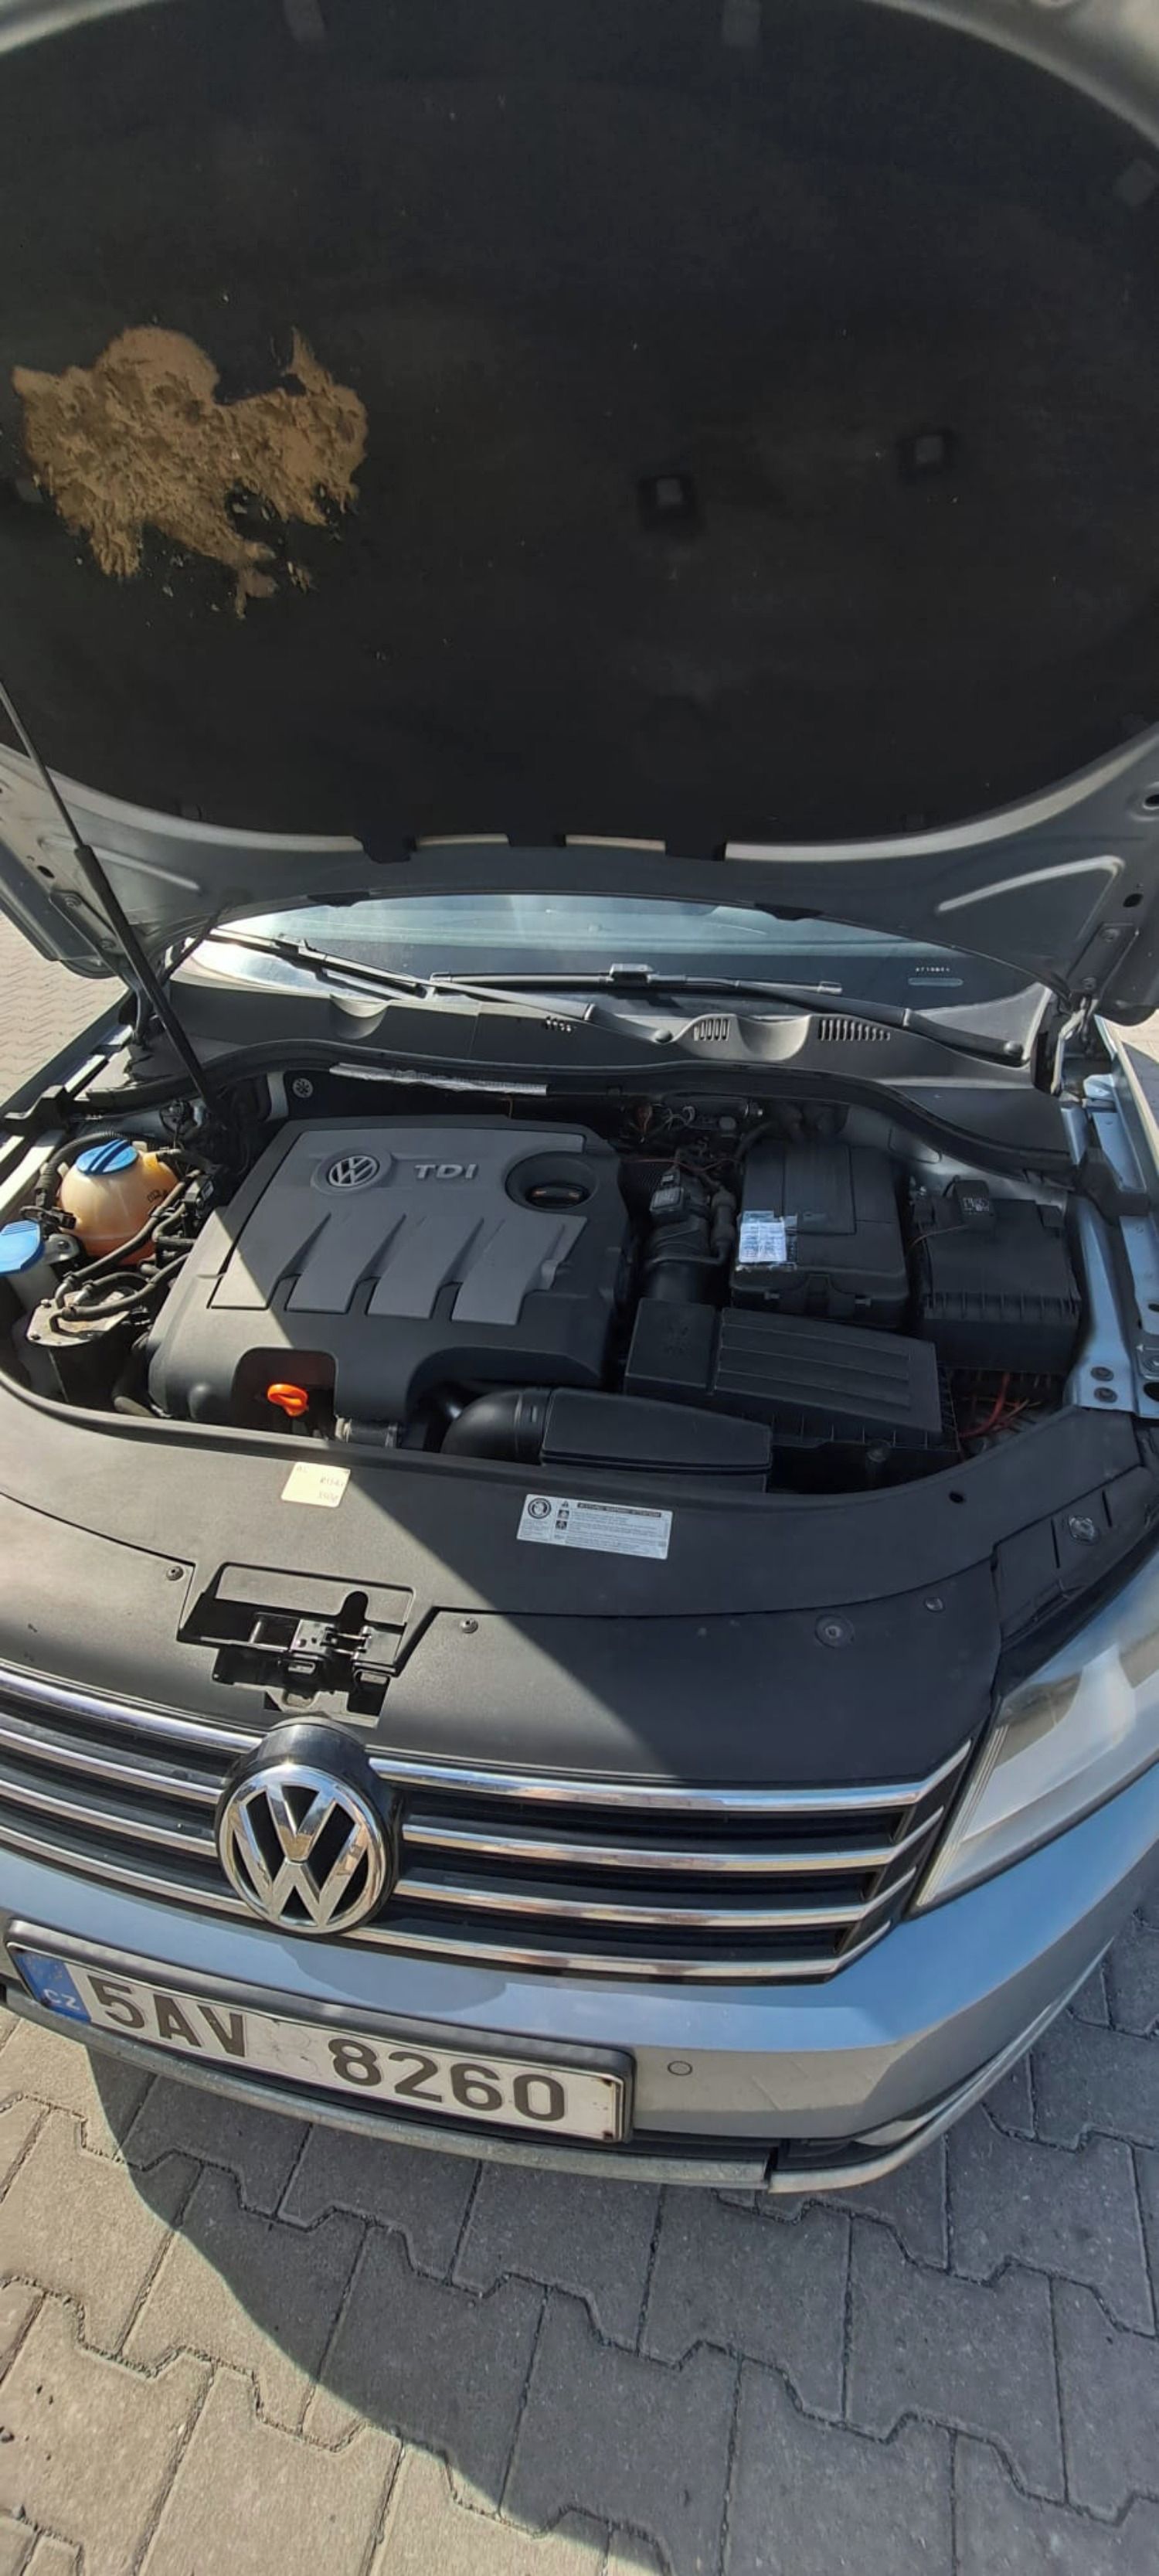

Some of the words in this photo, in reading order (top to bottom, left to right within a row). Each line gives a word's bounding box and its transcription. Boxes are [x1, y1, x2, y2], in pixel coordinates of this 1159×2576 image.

[328, 1155, 378, 1187] VW
[414, 1163, 477, 1179] TDI
[219, 1764, 386, 1934] VW
[43, 1989, 80, 2009] CZ
[87, 1975, 246, 2057] 5AV
[328, 2038, 566, 2122] 8260
